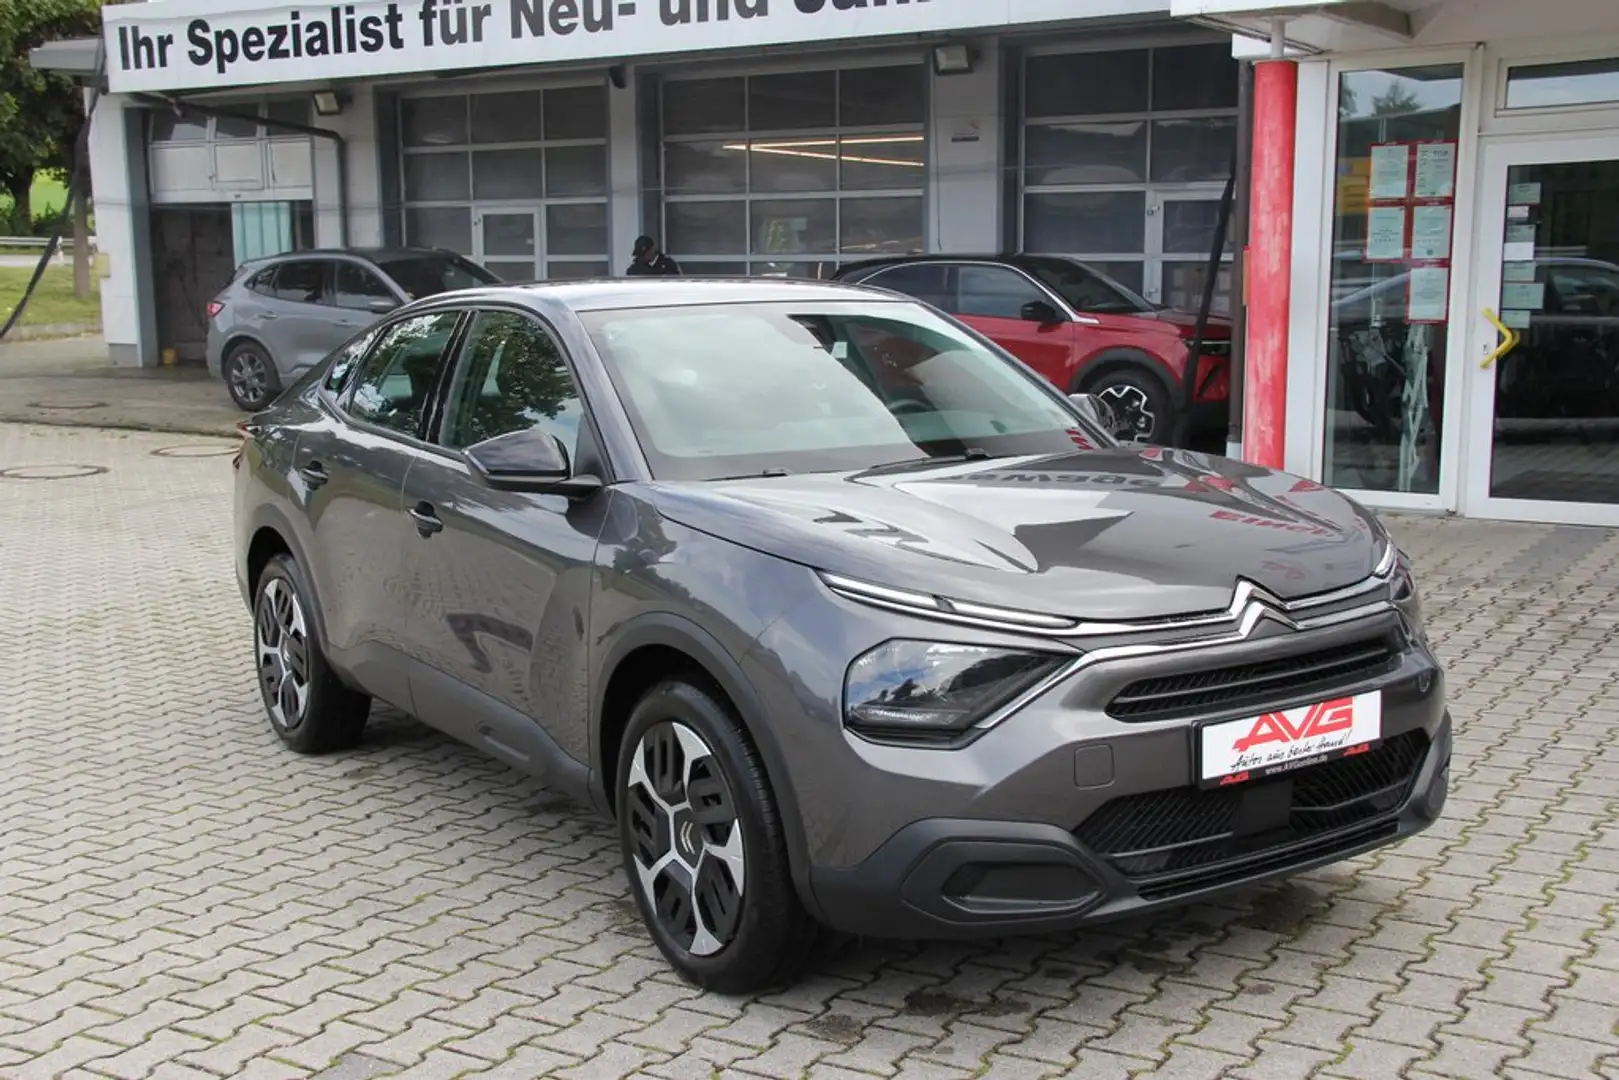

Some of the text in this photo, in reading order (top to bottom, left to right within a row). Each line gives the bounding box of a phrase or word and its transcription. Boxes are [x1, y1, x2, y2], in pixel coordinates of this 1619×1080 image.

[118, 26, 174, 71] Ihr
[187, 10, 405, 75] Spezialist
[419, 0, 492, 46] für
[510, 0, 636, 39] Neu-
[1233, 696, 1354, 753] AVG
